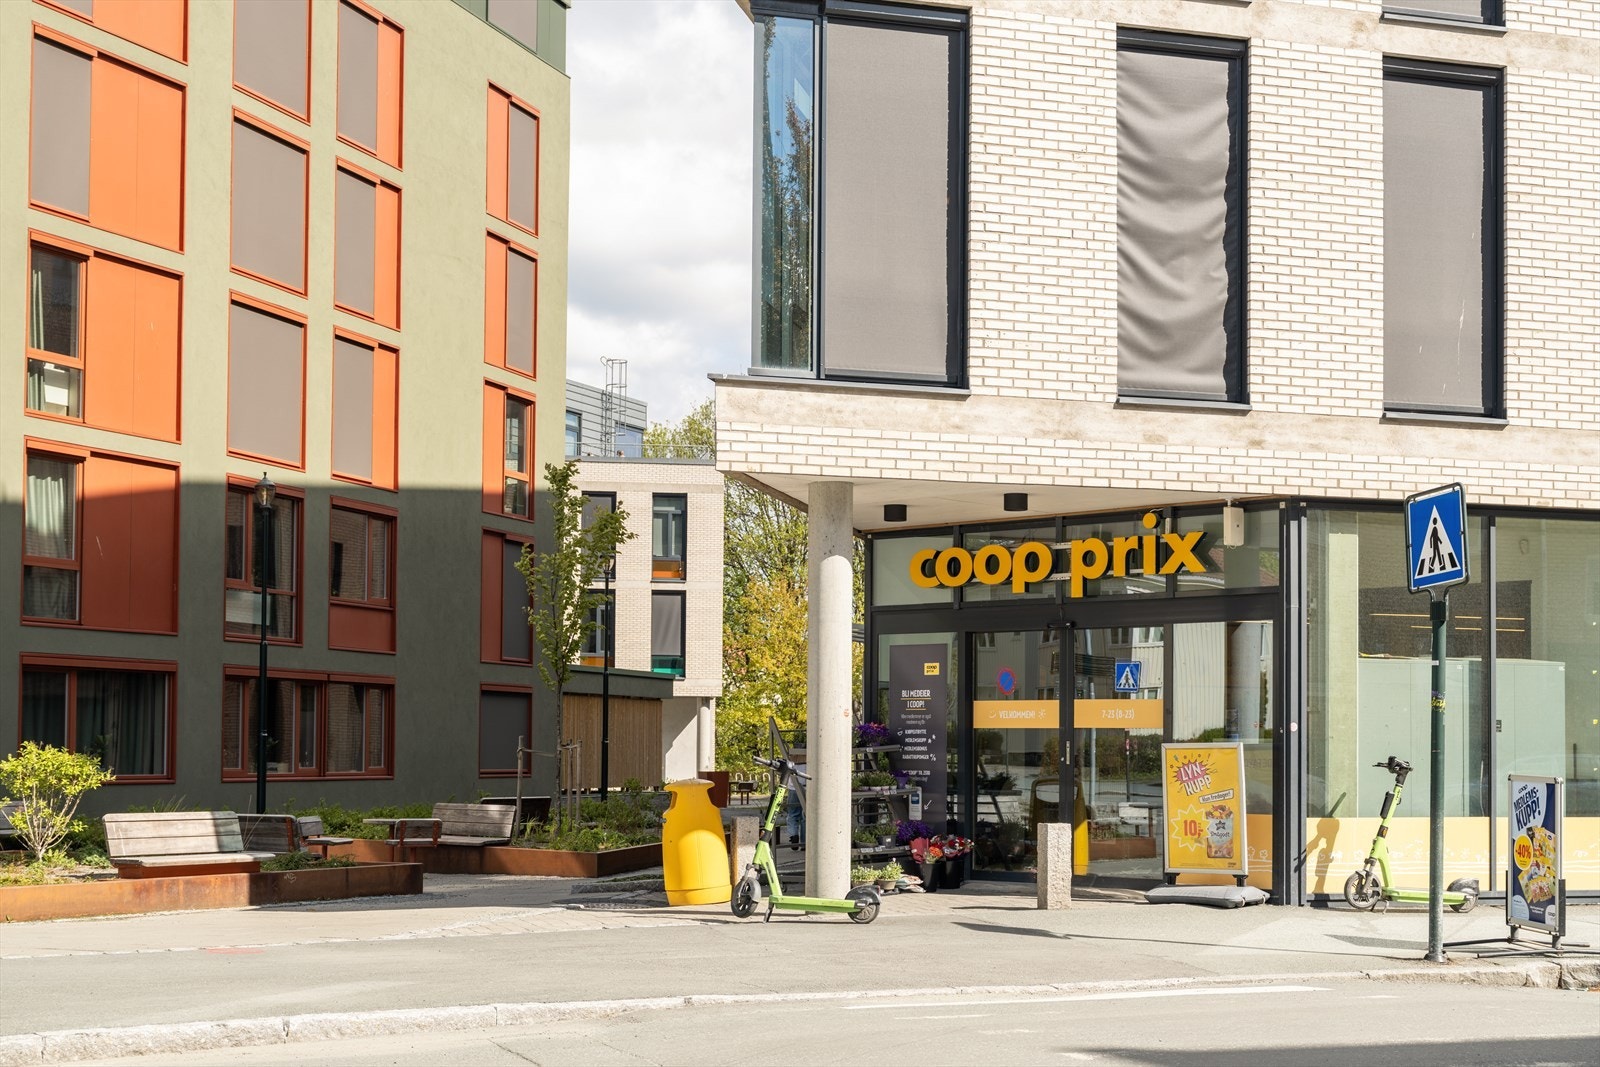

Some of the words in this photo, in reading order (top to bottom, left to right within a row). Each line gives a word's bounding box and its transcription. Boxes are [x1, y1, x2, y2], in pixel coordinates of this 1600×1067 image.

[909, 541, 1053, 594] coop
[1071, 512, 1208, 598] prix
[910, 690, 931, 698] MEDEIER
[999, 711, 1036, 719] VELKOMMEN!
[1102, 709, 1115, 718] 7-23
[1184, 775, 1212, 796] KUPP
[1515, 797, 1541, 831] KUPP!
